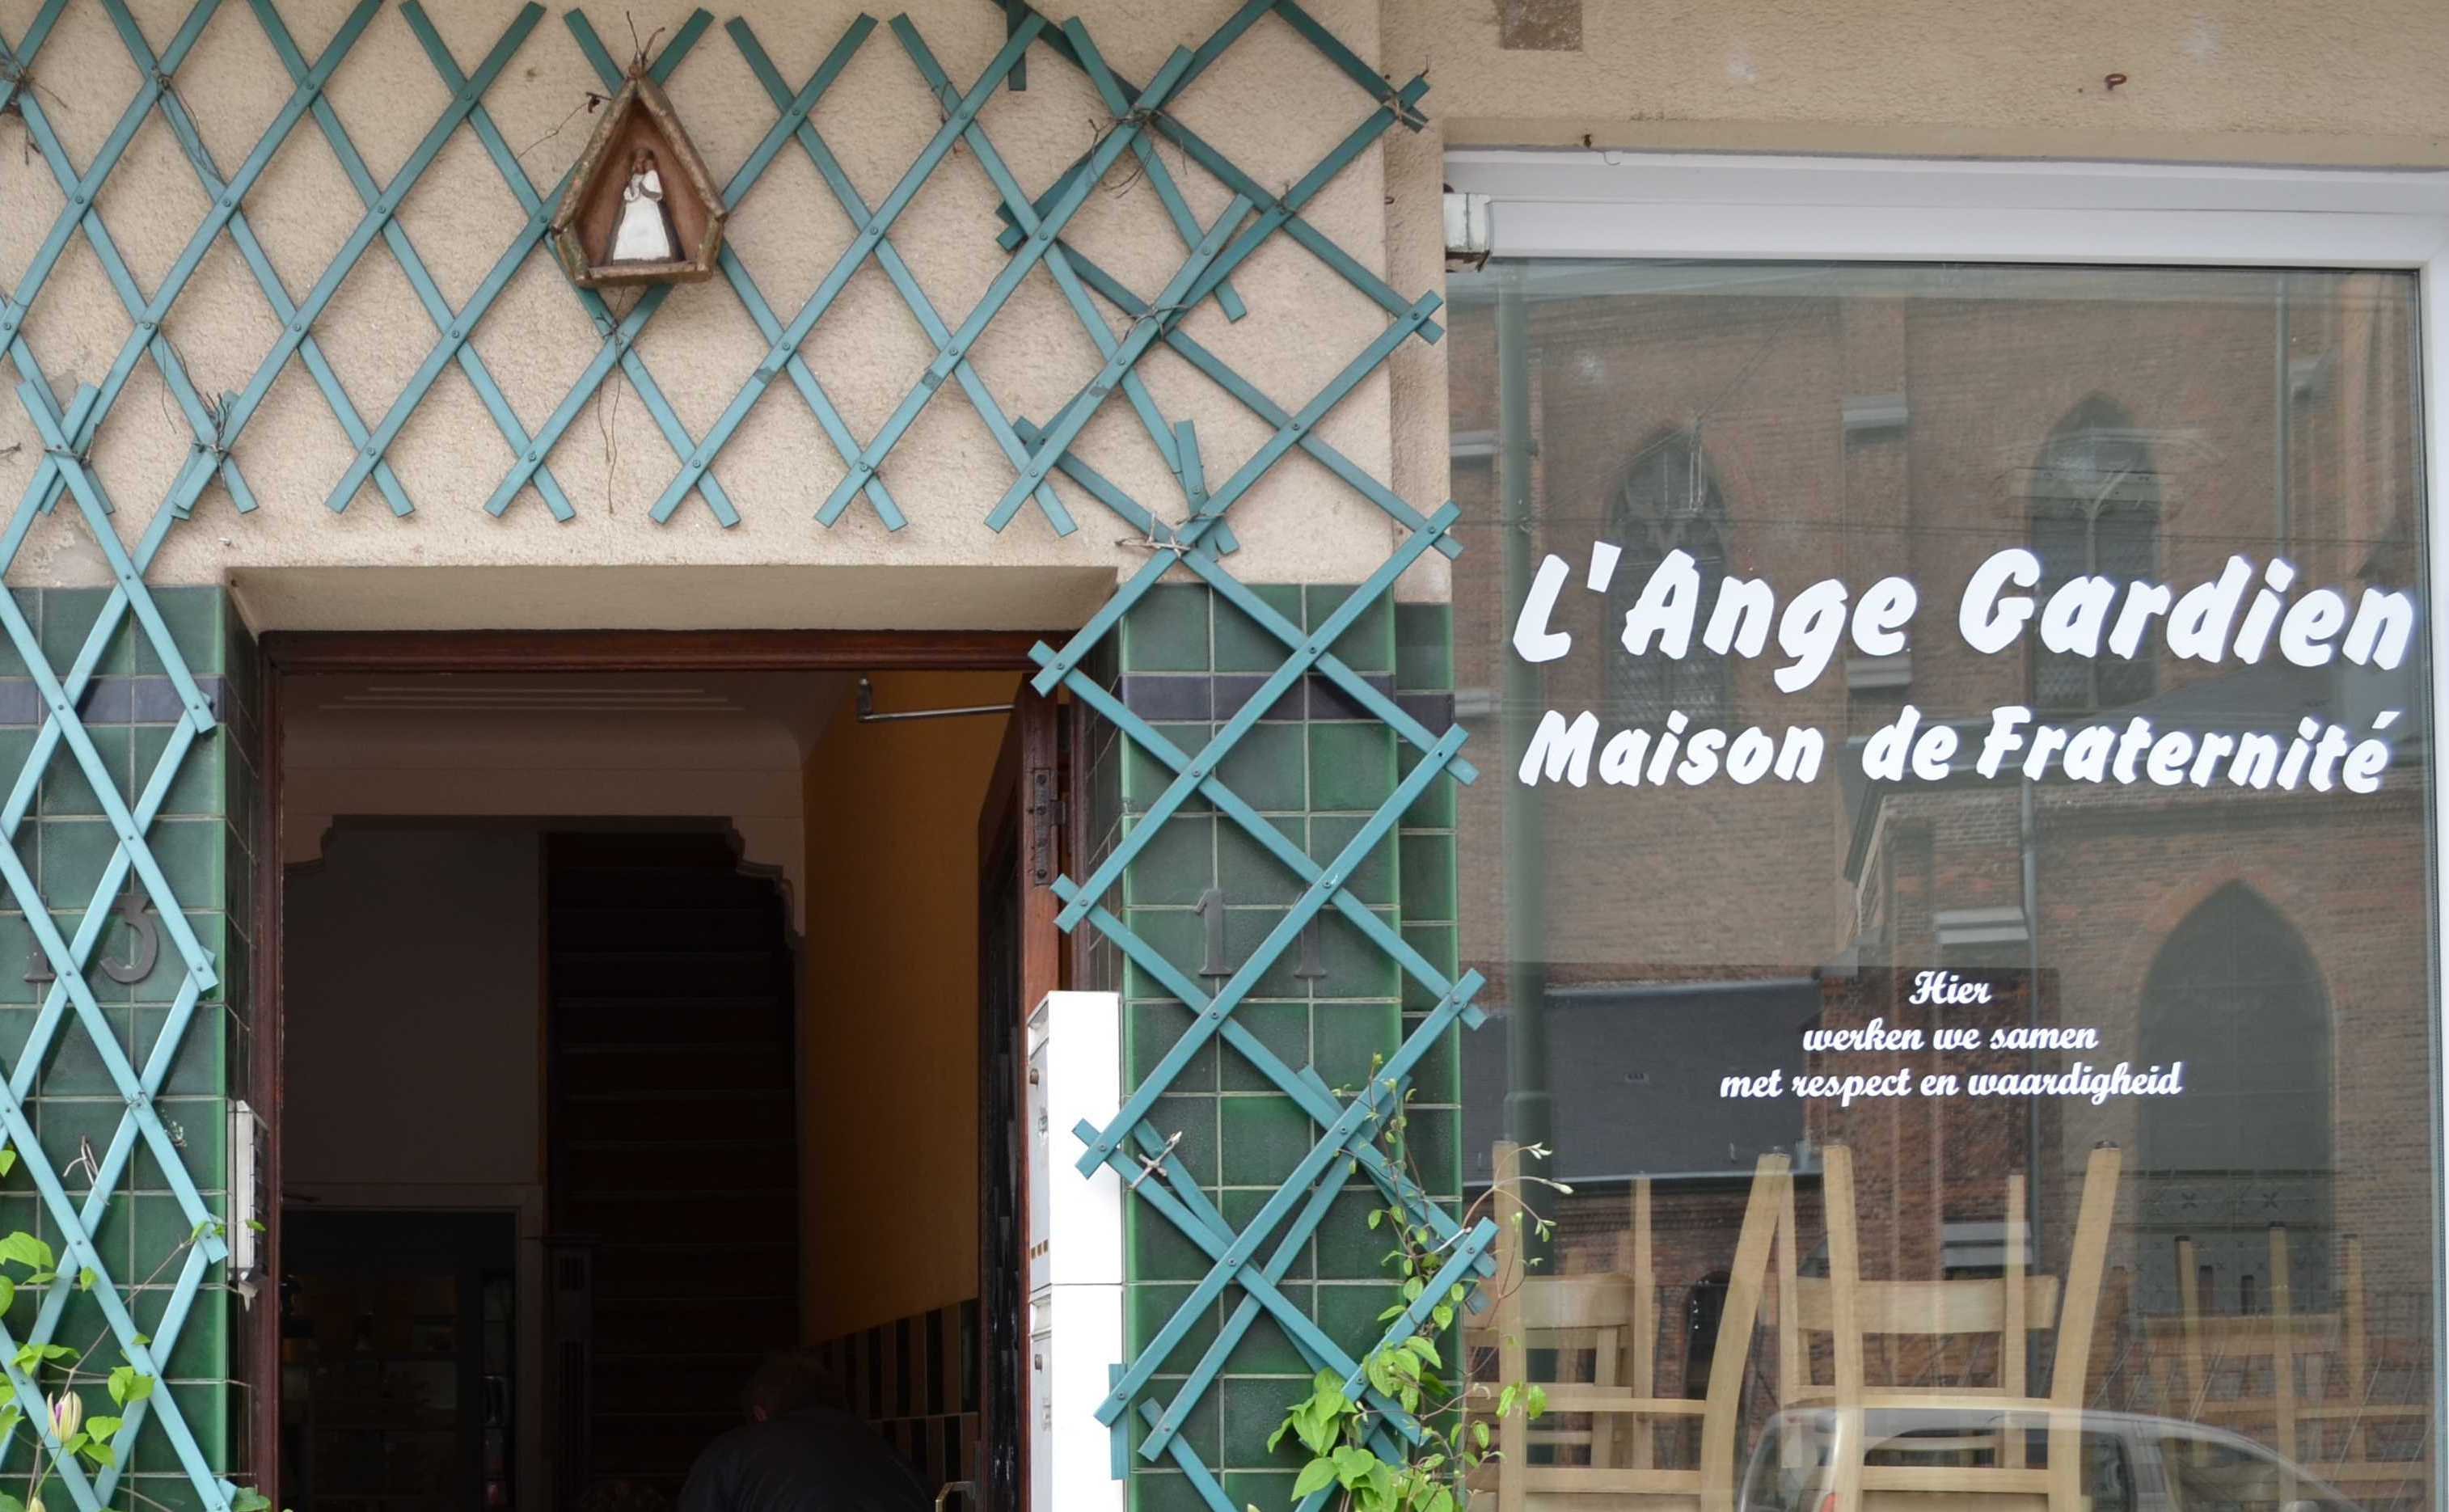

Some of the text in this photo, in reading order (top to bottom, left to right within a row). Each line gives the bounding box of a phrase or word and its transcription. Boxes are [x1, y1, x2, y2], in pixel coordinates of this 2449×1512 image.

[1513, 540, 2413, 693] L'Ange Gardien
[1518, 704, 2400, 794] Maison de Fraternité
[1908, 970, 1992, 1004] Hier
[1803, 1017, 2100, 1051] werken we samen
[1720, 1061, 2184, 1108] met respect en waardigheid
